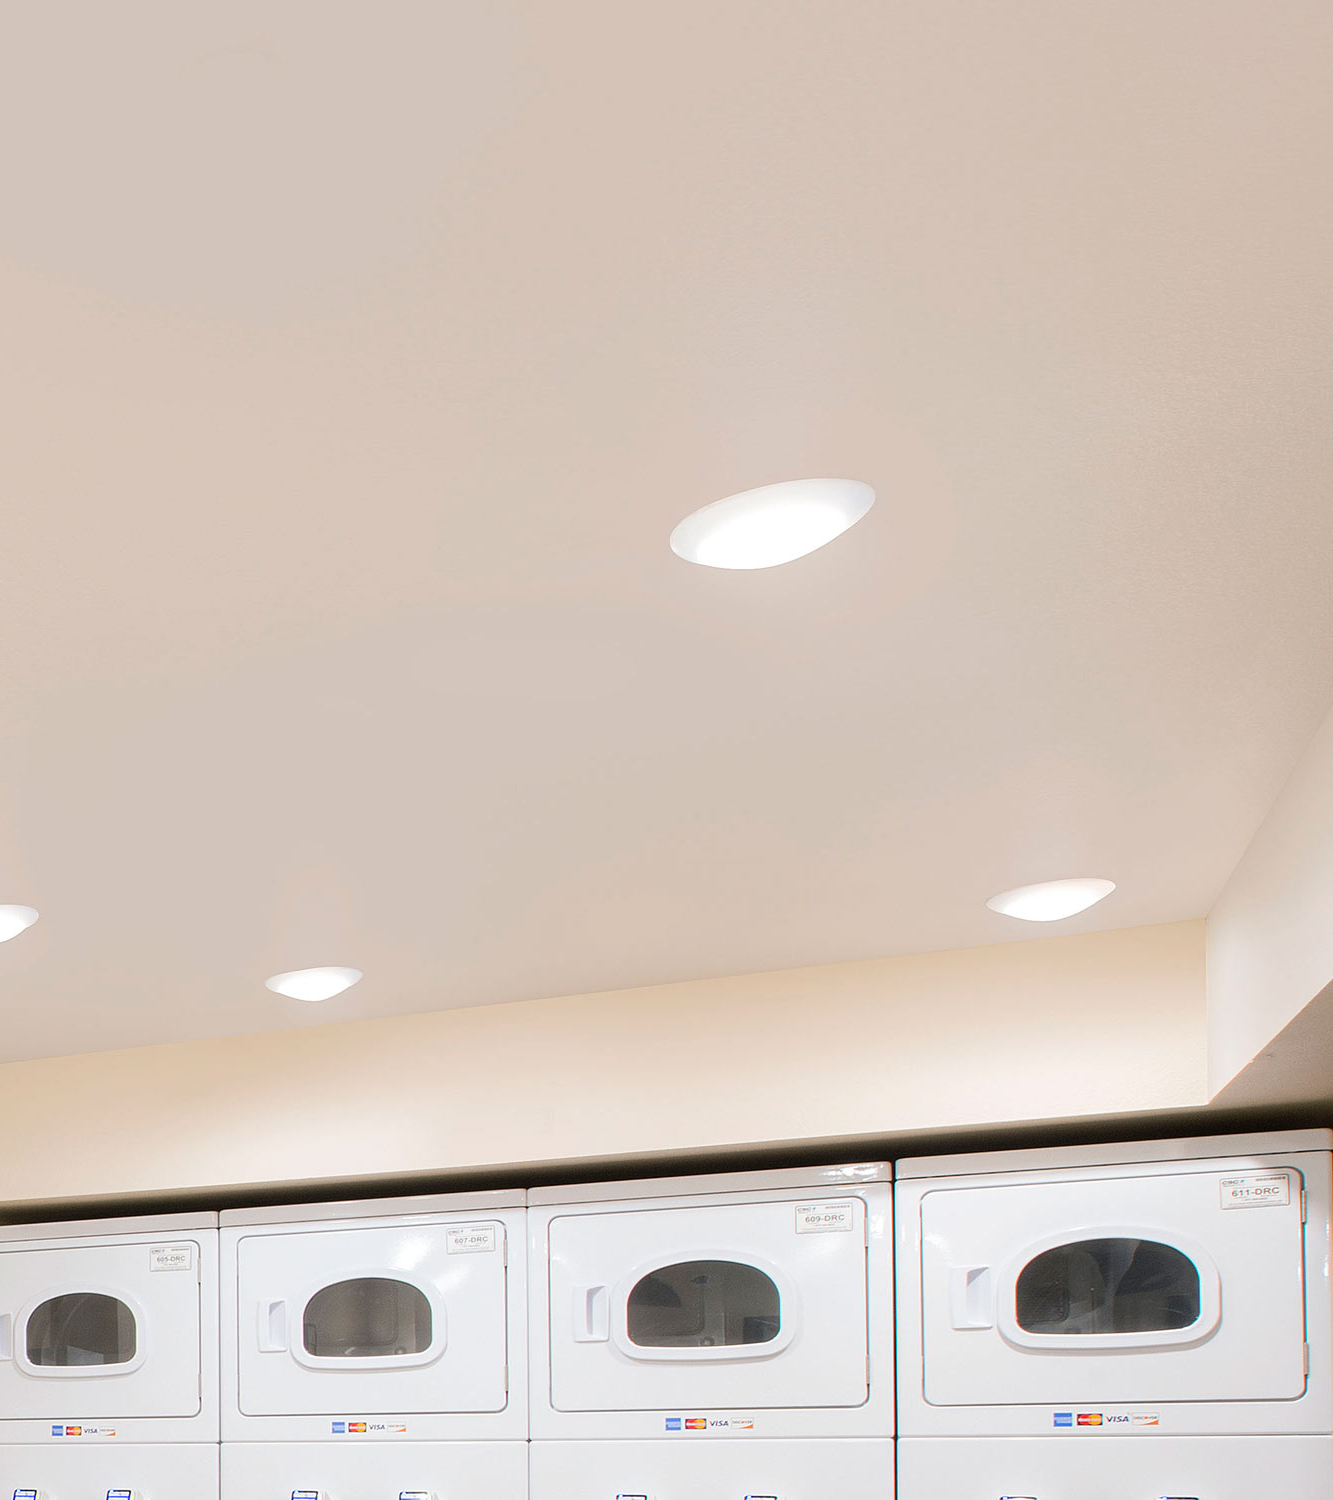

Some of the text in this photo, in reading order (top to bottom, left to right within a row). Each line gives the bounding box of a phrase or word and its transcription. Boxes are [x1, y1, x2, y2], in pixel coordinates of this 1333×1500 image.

[1231, 1187, 1280, 1197] 611-DRC
[805, 1214, 845, 1223] 609-DRC
[1106, 1415, 1129, 1423] VISA
